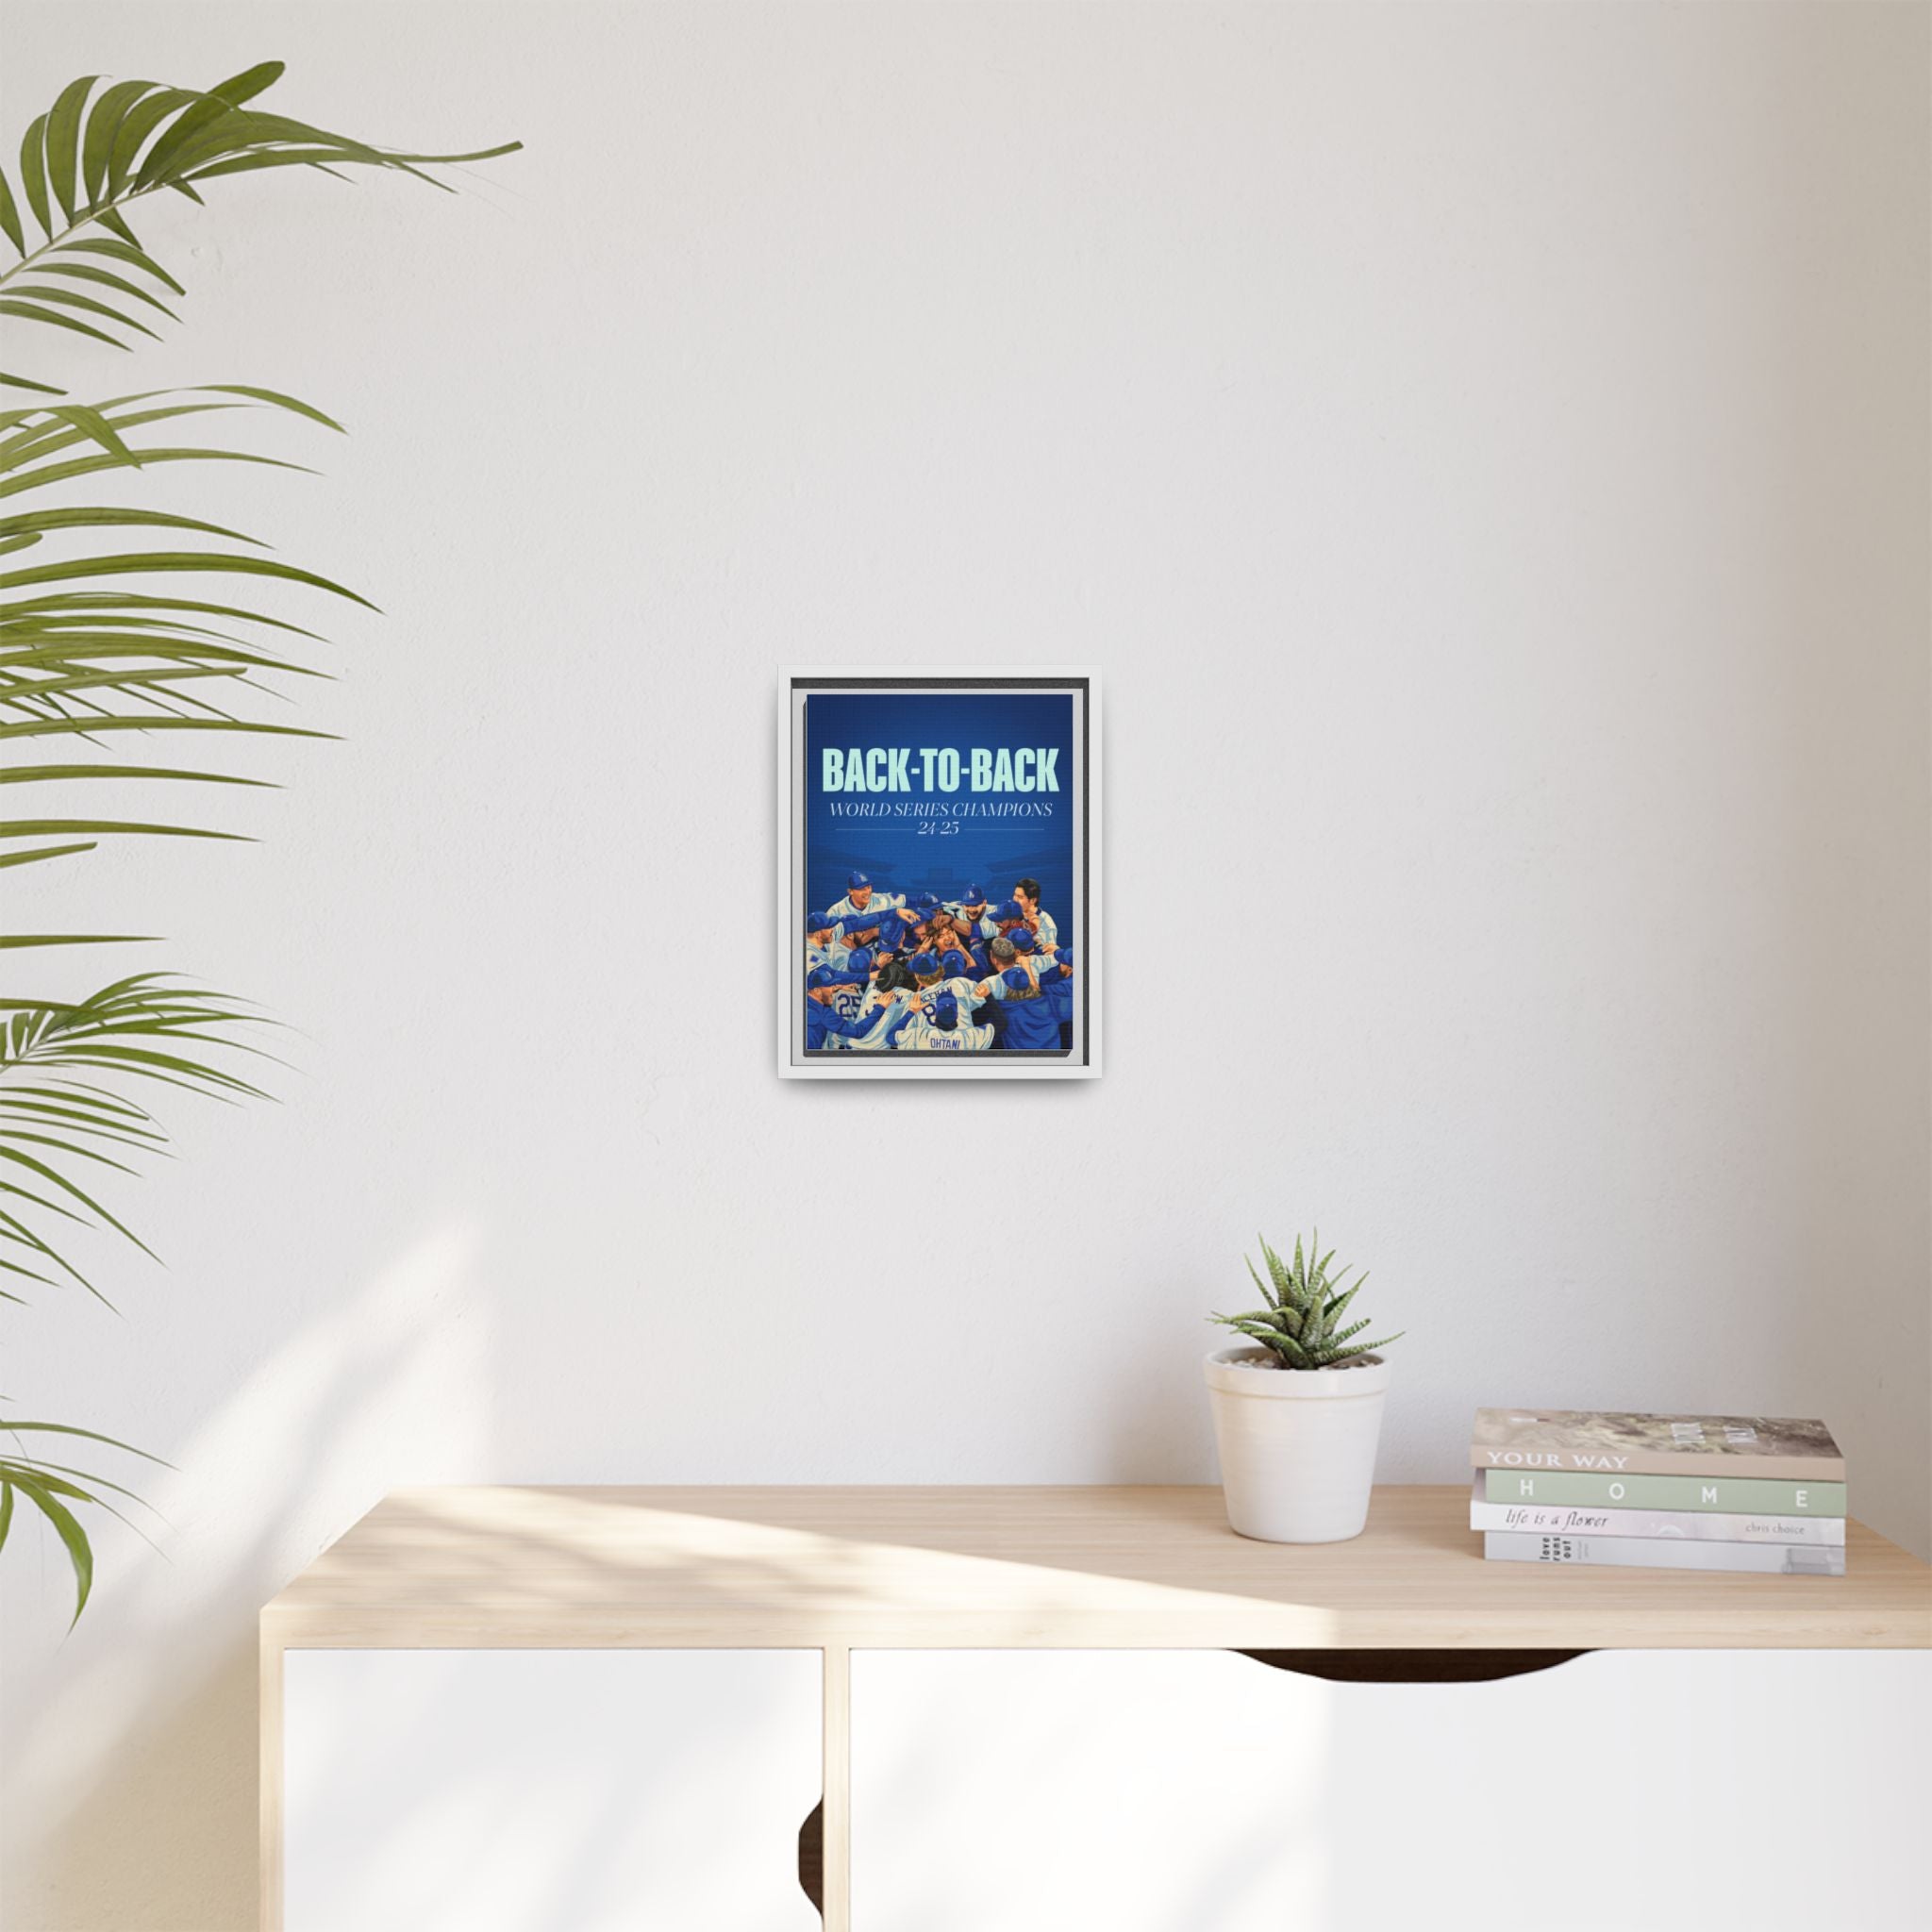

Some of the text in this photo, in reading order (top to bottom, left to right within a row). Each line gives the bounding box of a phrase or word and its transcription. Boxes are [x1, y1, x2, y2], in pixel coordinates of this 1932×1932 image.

[822, 747, 1060, 792] BACK-TO-BACK
[829, 802, 1053, 817] WORLD SERIES CHAMPIONS
[930, 1038, 961, 1050] OHTANI
[1487, 1451, 1629, 1469] YOUR WAY
[1506, 1508, 1610, 1532] life is a flower
[1745, 1521, 1770, 1534] chris
[1539, 1537, 1550, 1559] love
[1552, 1537, 1561, 1561] runs
[1562, 1541, 1572, 1558] out
